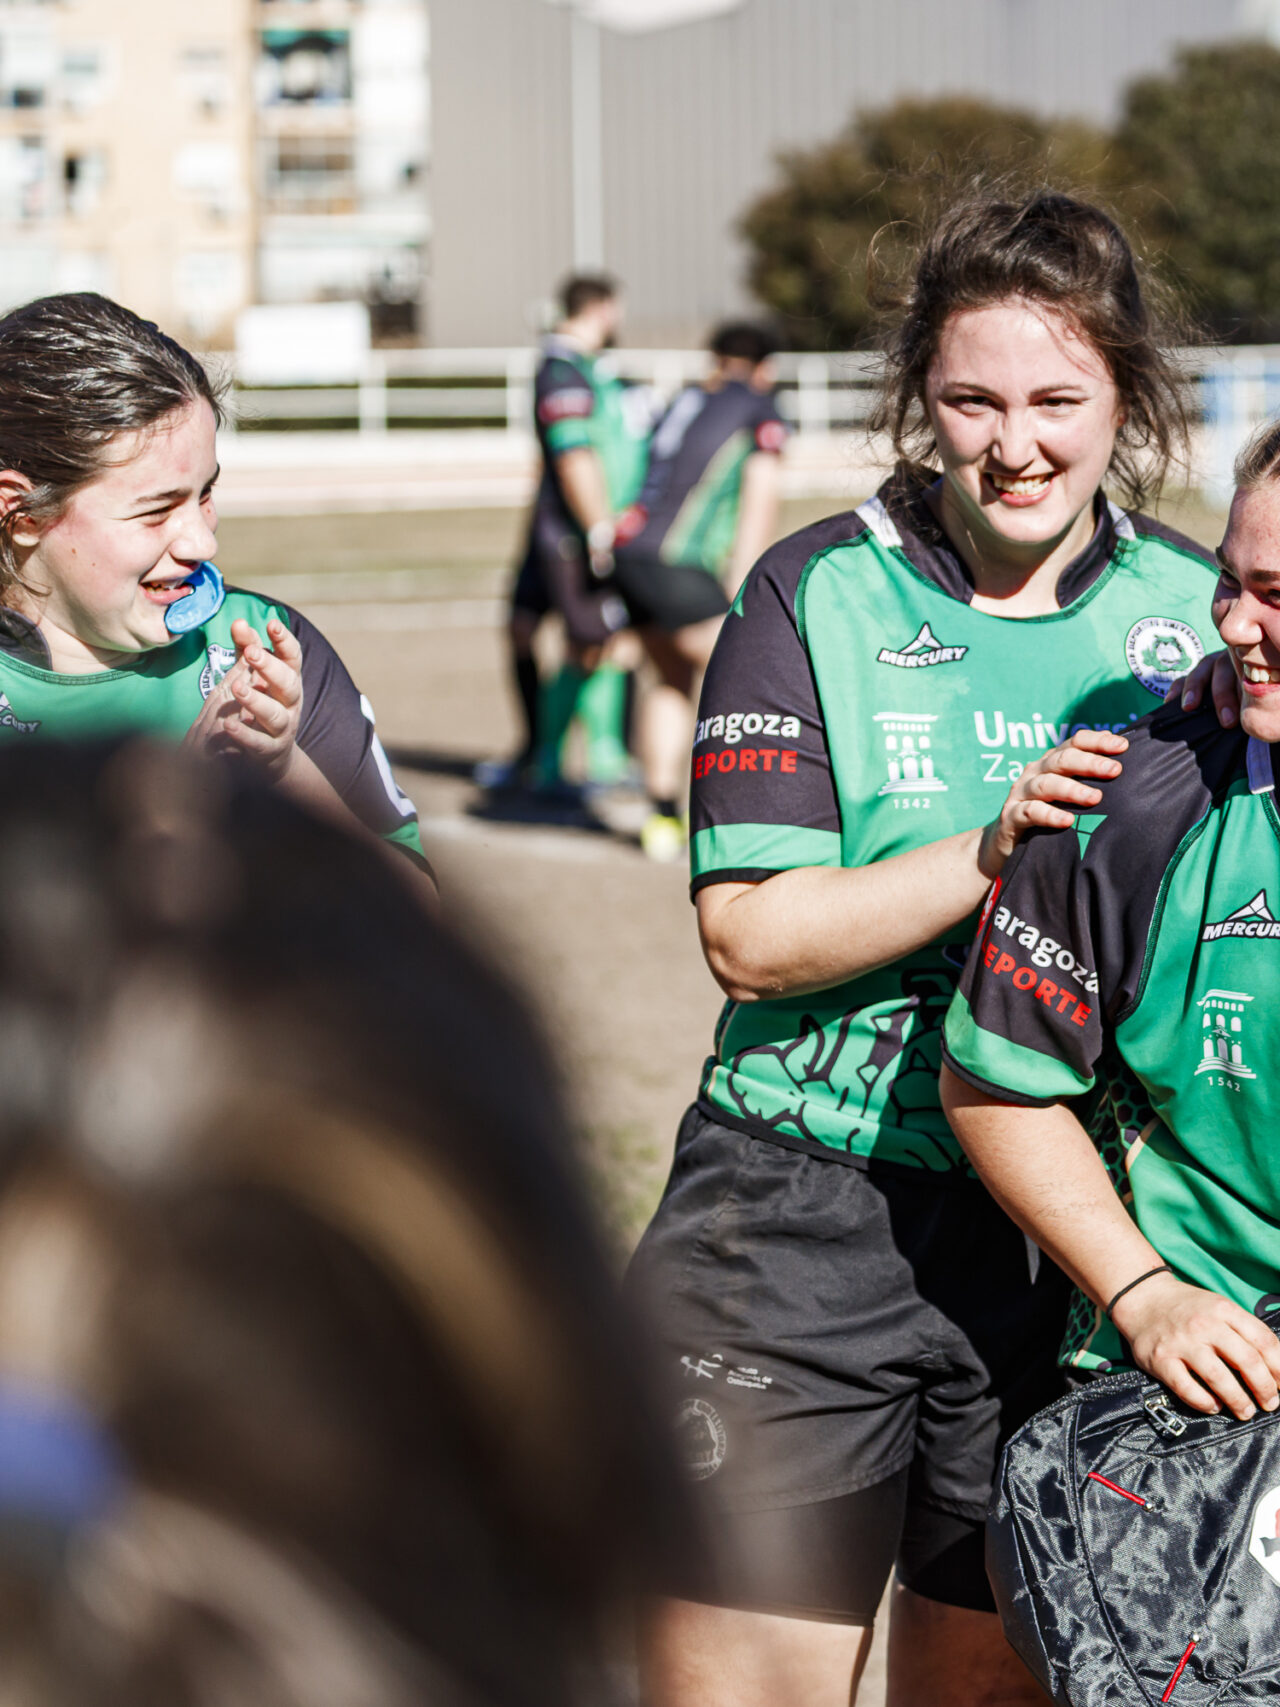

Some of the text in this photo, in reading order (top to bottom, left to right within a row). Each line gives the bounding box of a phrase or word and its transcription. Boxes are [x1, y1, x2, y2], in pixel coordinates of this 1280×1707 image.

[878, 647, 967, 667] MERCURY
[694, 713, 801, 744] aragoza
[694, 749, 798, 779] EPORTE
[893, 798, 930, 809] 1542
[993, 904, 1099, 994] aragoza
[982, 940, 1092, 1027] EPORTE
[1208, 1076, 1241, 1092] 1542
